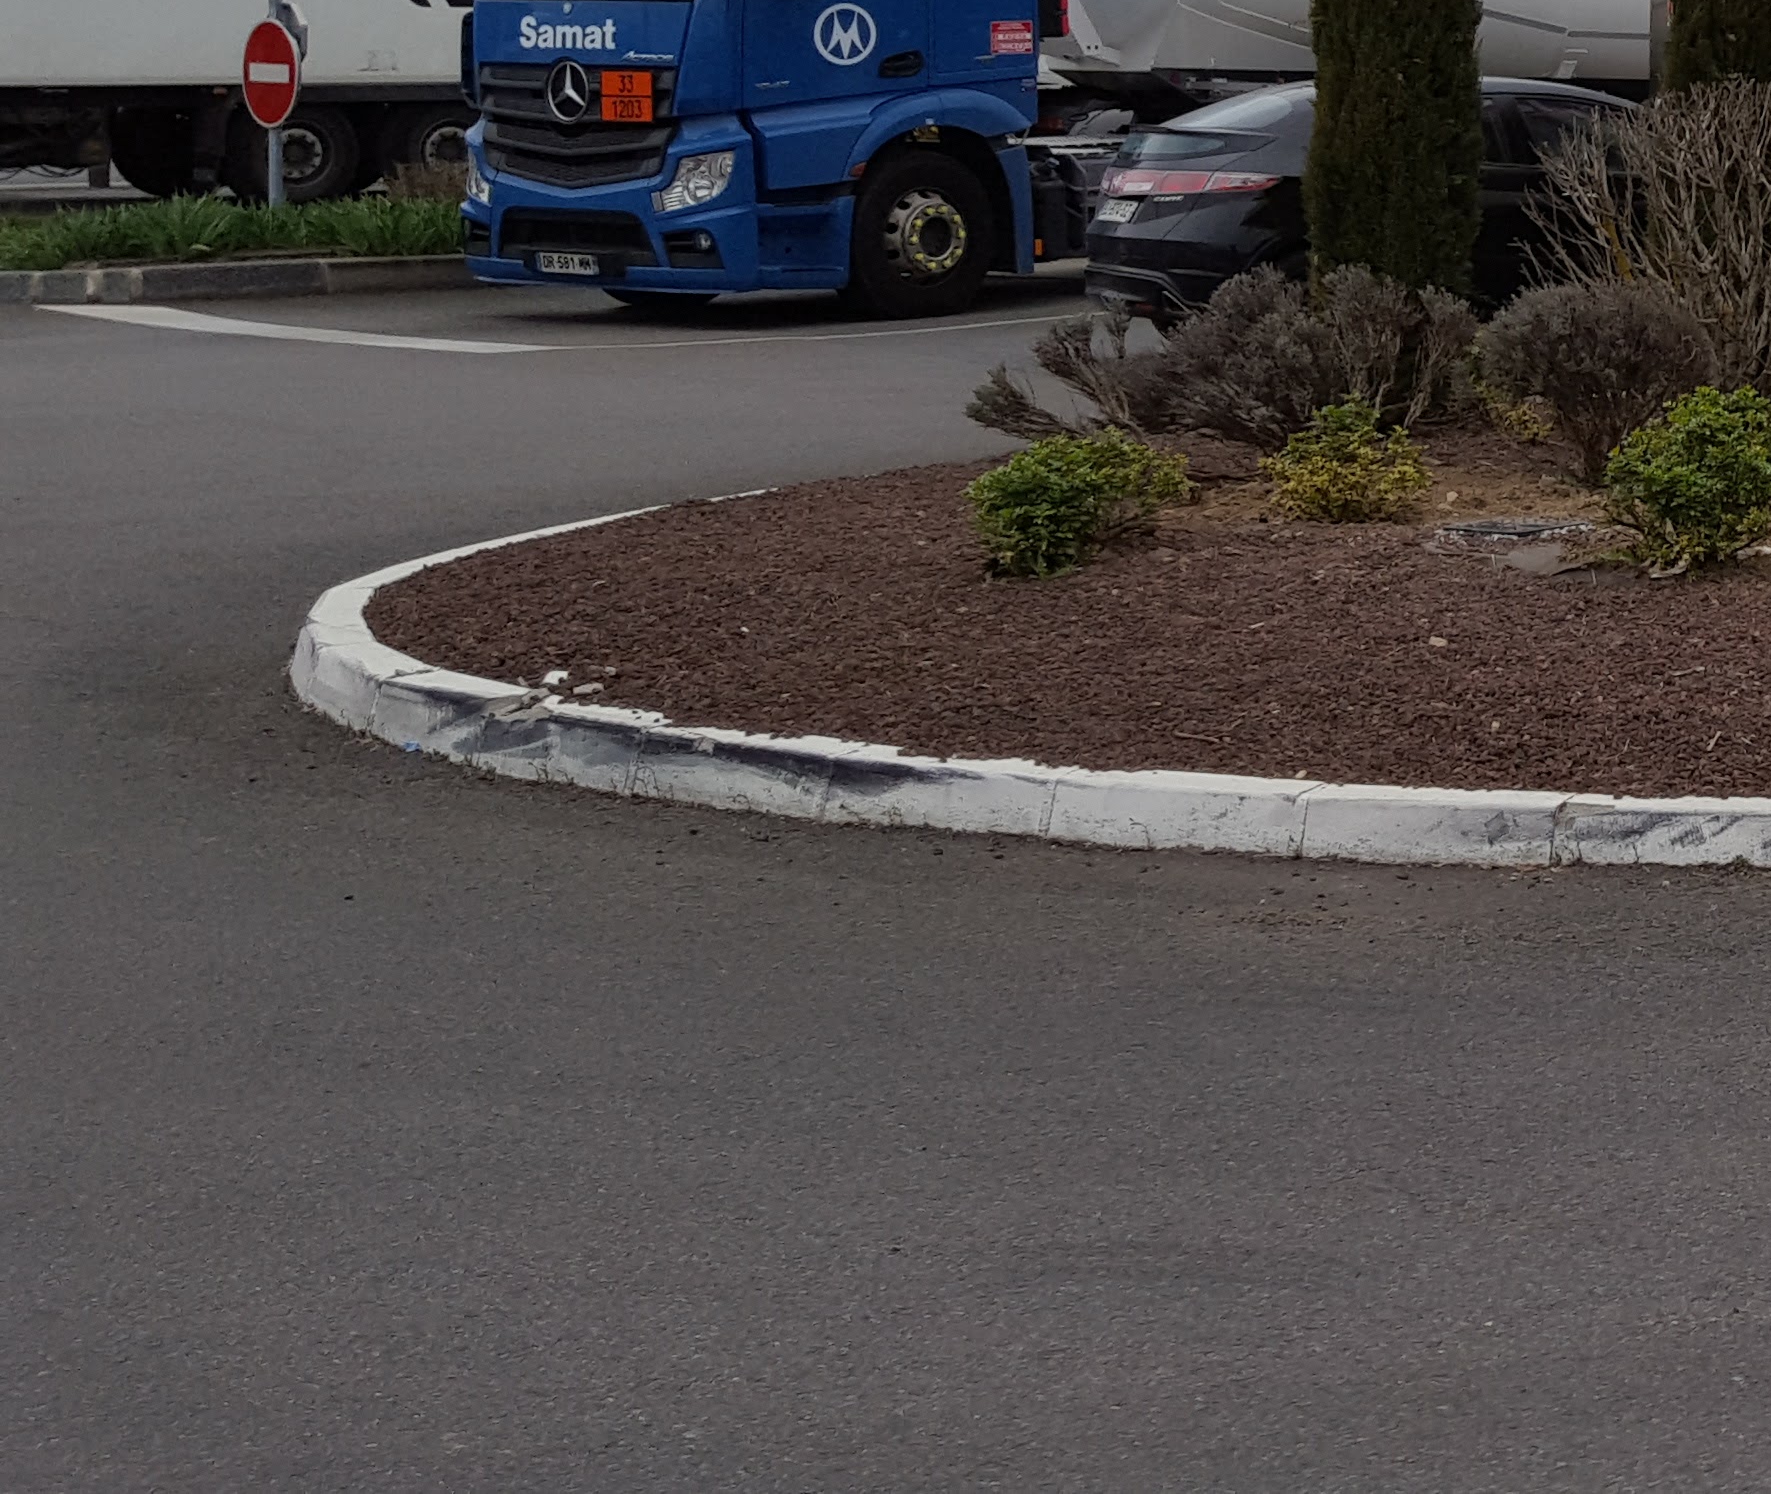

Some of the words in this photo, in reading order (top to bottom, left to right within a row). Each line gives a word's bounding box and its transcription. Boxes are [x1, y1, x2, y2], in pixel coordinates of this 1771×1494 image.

[519, 15, 616, 49] Samat
[618, 75, 634, 93] 33
[612, 99, 643, 119] 1203
